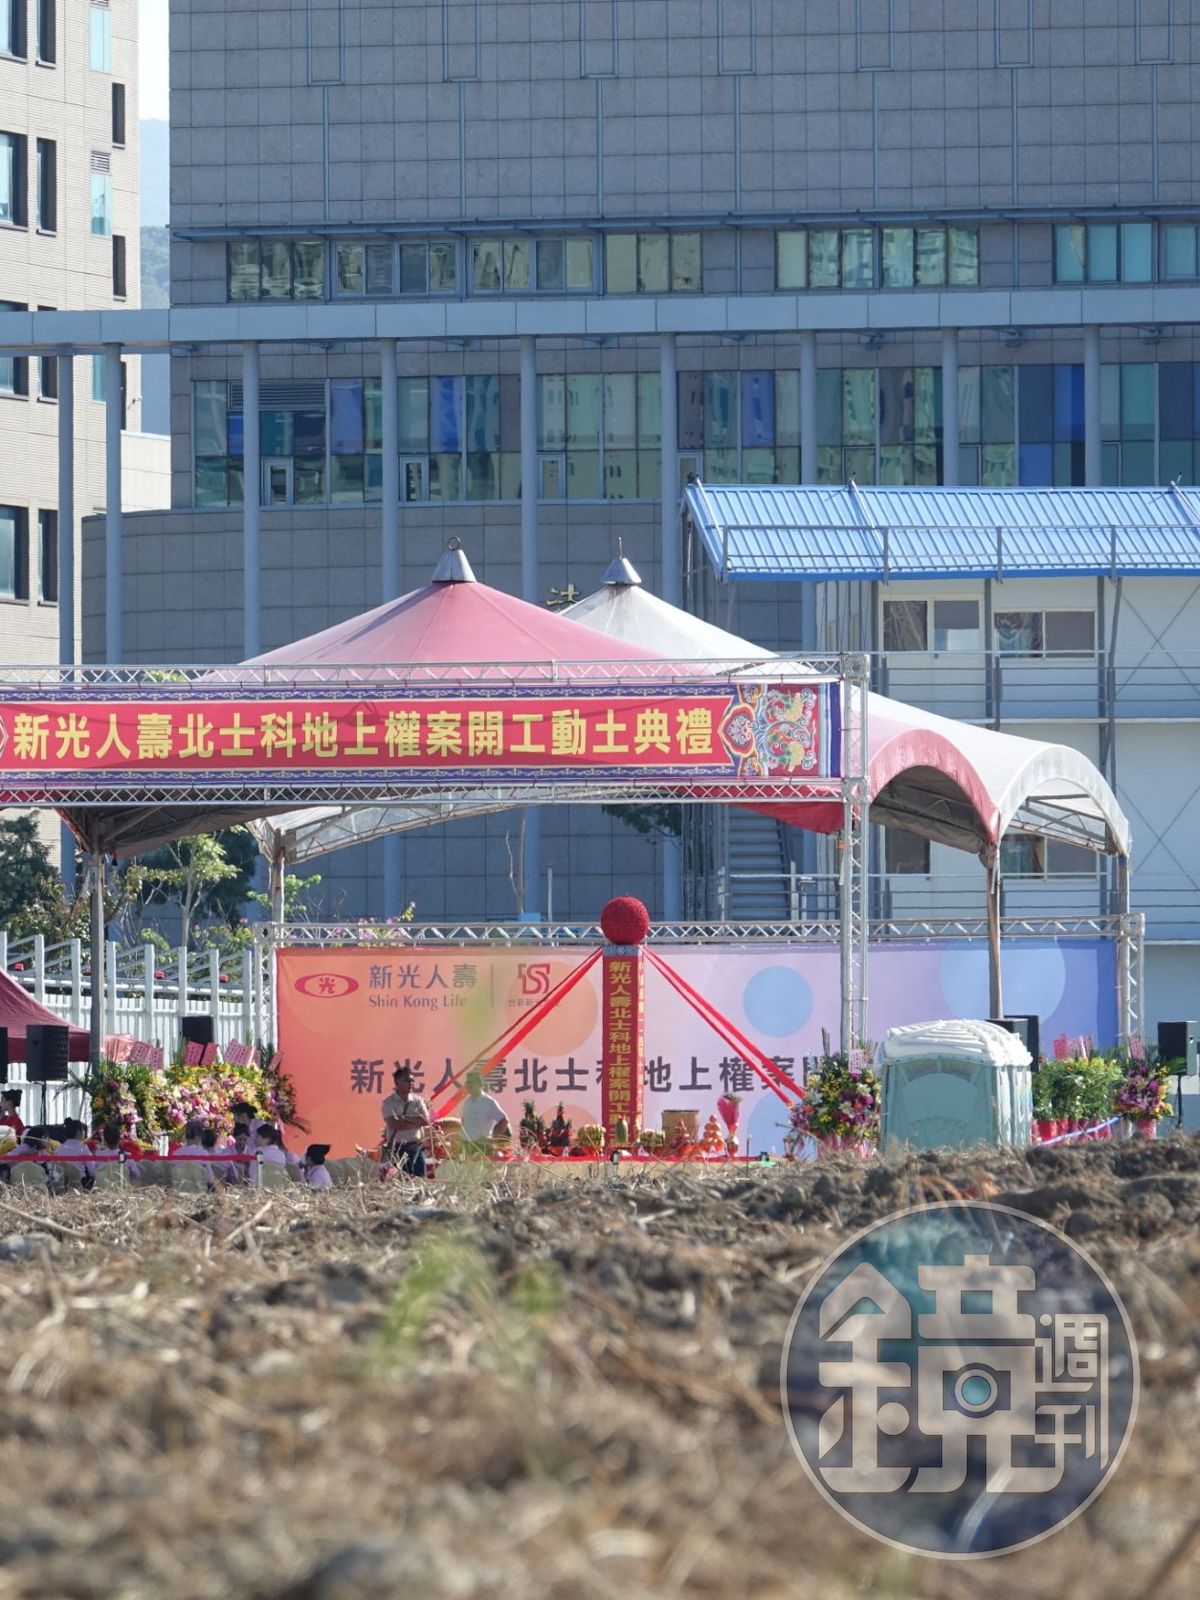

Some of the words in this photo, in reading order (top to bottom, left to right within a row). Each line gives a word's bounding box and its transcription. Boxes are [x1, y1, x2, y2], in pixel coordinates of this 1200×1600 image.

[13, 708, 713, 760] 新光人壽北士科地上權案開工動土典禮
[369, 963, 477, 990] 新光人壽
[369, 995, 398, 1008] Shin
[403, 995, 438, 1011] Kong
[443, 994, 467, 1008] Life
[351, 1056, 819, 1094] 新光人壽北士地上權案
